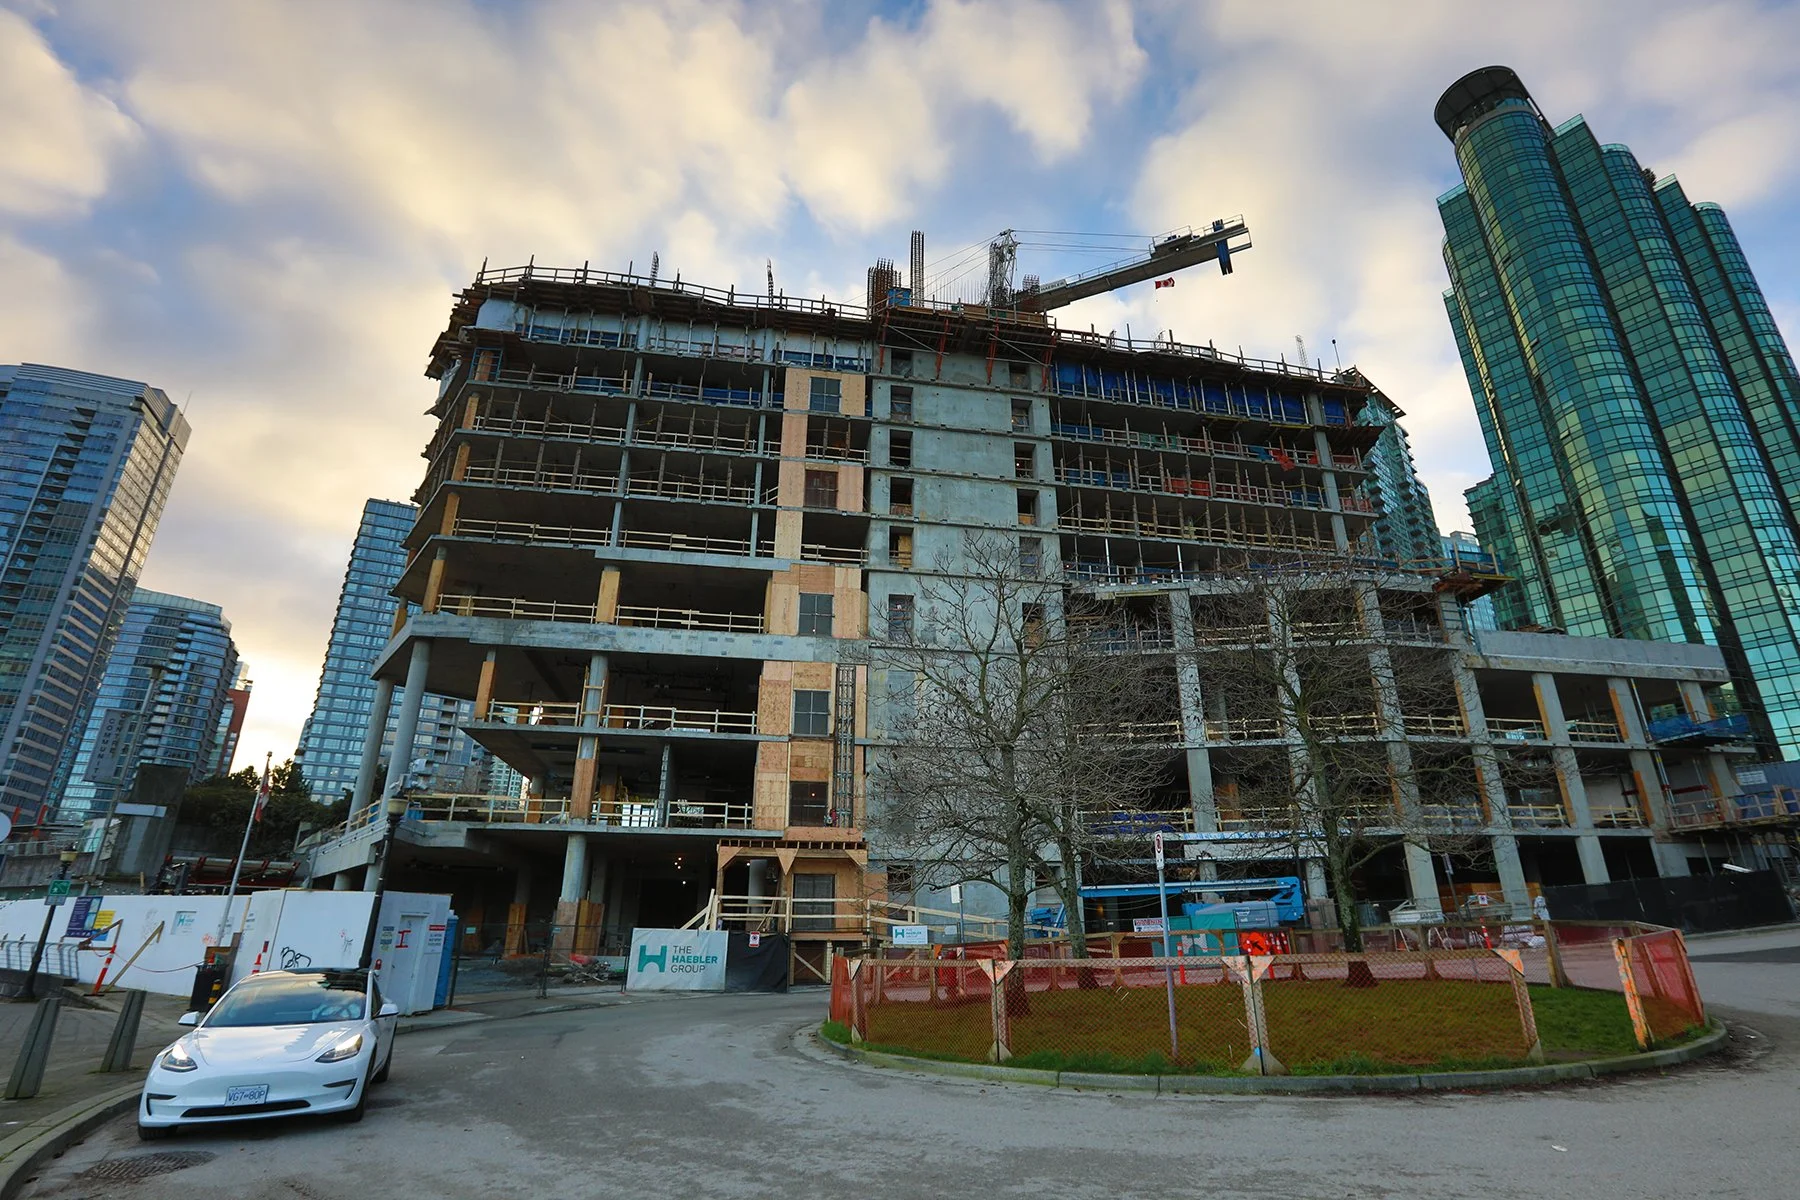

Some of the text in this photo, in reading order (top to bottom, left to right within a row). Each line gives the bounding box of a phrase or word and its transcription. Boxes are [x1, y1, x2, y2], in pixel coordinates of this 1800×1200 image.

[91, 718, 115, 779] COMMUNITY
[672, 945, 692, 954] THE
[671, 955, 718, 964] HAEBLER
[670, 965, 706, 974] GROUP
